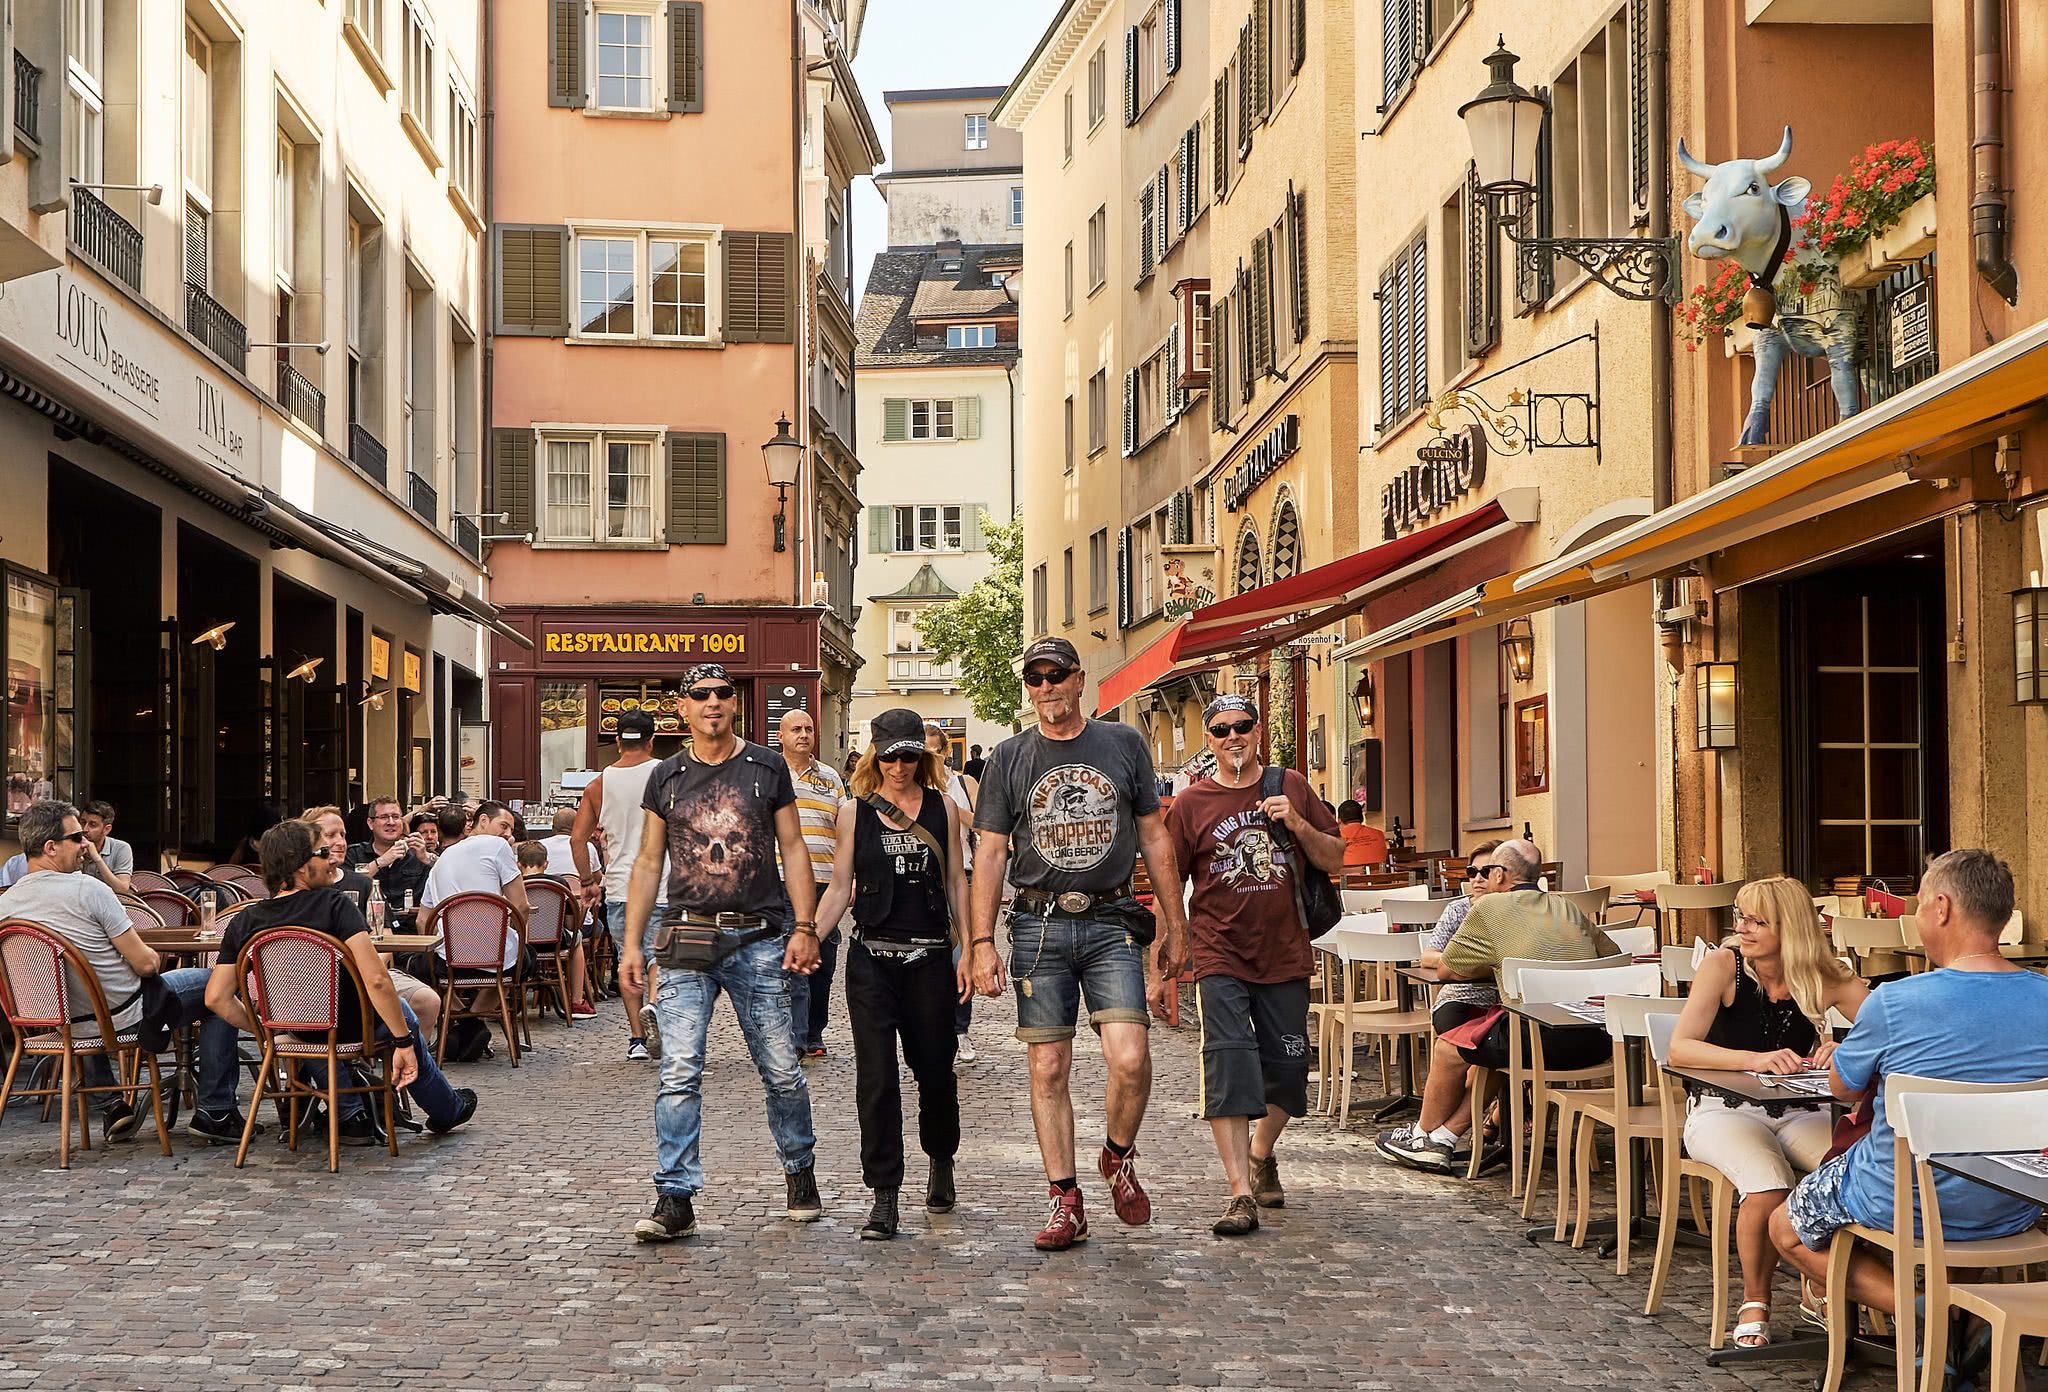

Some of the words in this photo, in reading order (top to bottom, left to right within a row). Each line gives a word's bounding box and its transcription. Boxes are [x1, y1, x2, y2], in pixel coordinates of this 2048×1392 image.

[56, 273, 109, 367] LOUIS
[112, 349, 160, 403] BRASSERIE
[196, 375, 227, 448] TINA
[229, 431, 244, 459] BAR
[1421, 449, 1463, 459] PULCINO
[1195, 585, 1217, 604] CITY
[546, 633, 696, 653] RESTAURANT
[701, 633, 746, 653] 1001
[1038, 819, 1113, 850] CHOPPERS
[1212, 816, 1239, 841] KING
[1050, 847, 1074, 859] LONG
[1074, 845, 1103, 857] BEACH
